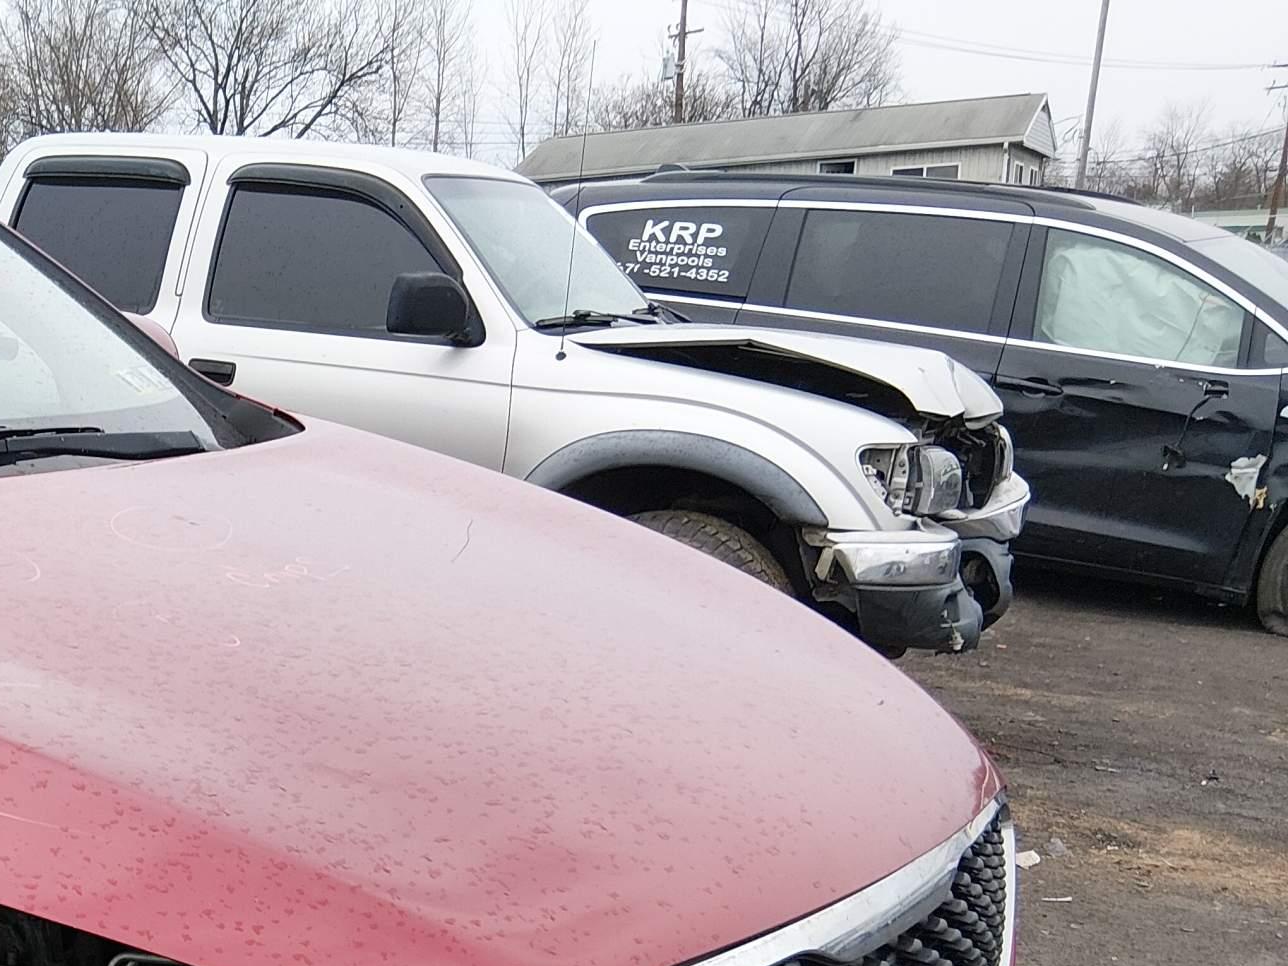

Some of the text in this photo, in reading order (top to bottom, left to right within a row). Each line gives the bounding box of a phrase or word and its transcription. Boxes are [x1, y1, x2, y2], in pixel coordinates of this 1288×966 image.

[642, 219, 723, 245] KRP
[628, 238, 727, 257] Enterprises
[636, 250, 713, 268] Vanpools
